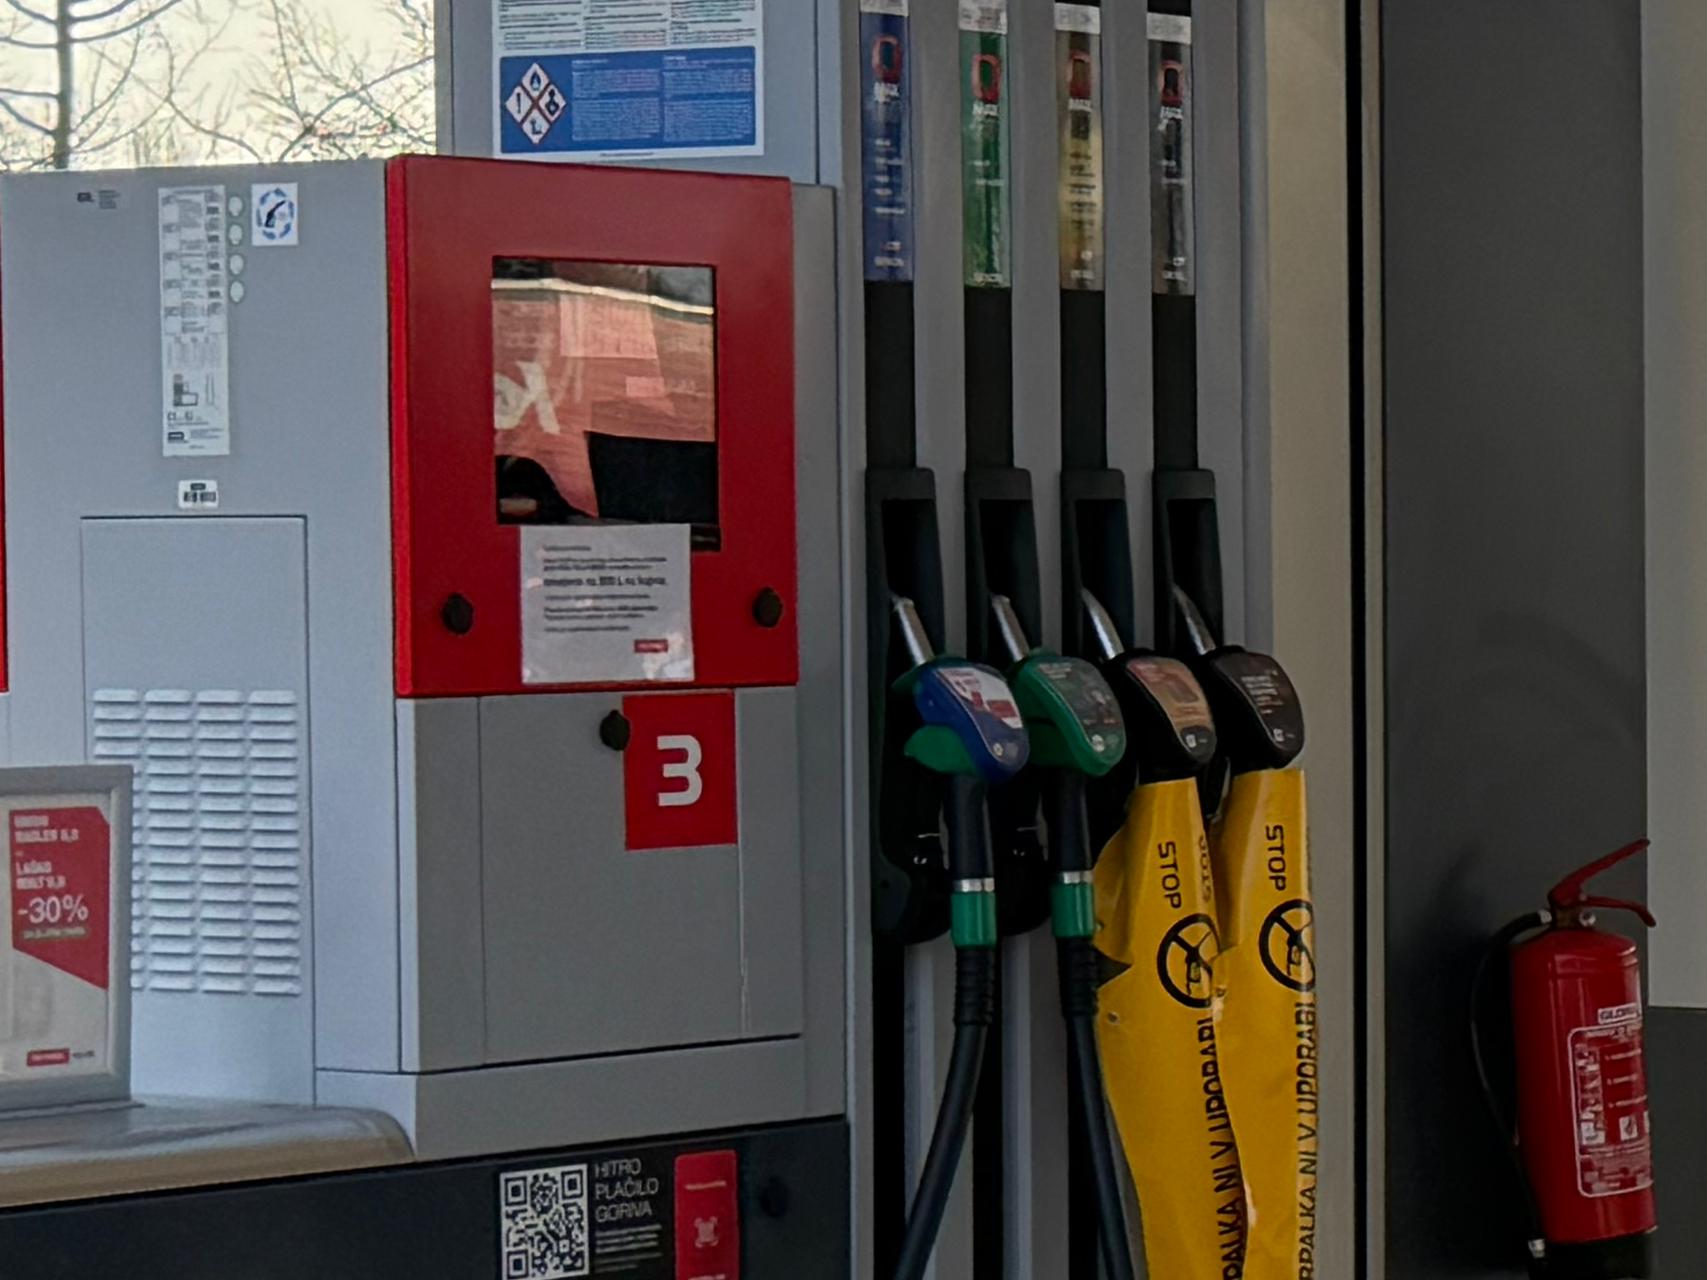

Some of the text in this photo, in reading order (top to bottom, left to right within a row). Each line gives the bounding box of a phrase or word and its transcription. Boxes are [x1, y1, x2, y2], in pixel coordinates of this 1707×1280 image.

[656, 734, 702, 807] 3
[1265, 824, 1287, 891] STOP
[1158, 841, 1182, 909] STOP
[17, 894, 89, 924] -30%
[1295, 1002, 1318, 1115] UPORABI
[1297, 1123, 1317, 1141] V
[1210, 1141, 1236, 1160] V
[1298, 1150, 1319, 1176] NI
[593, 1157, 642, 1179] HITRO
[593, 1177, 660, 1201] PLAČILO
